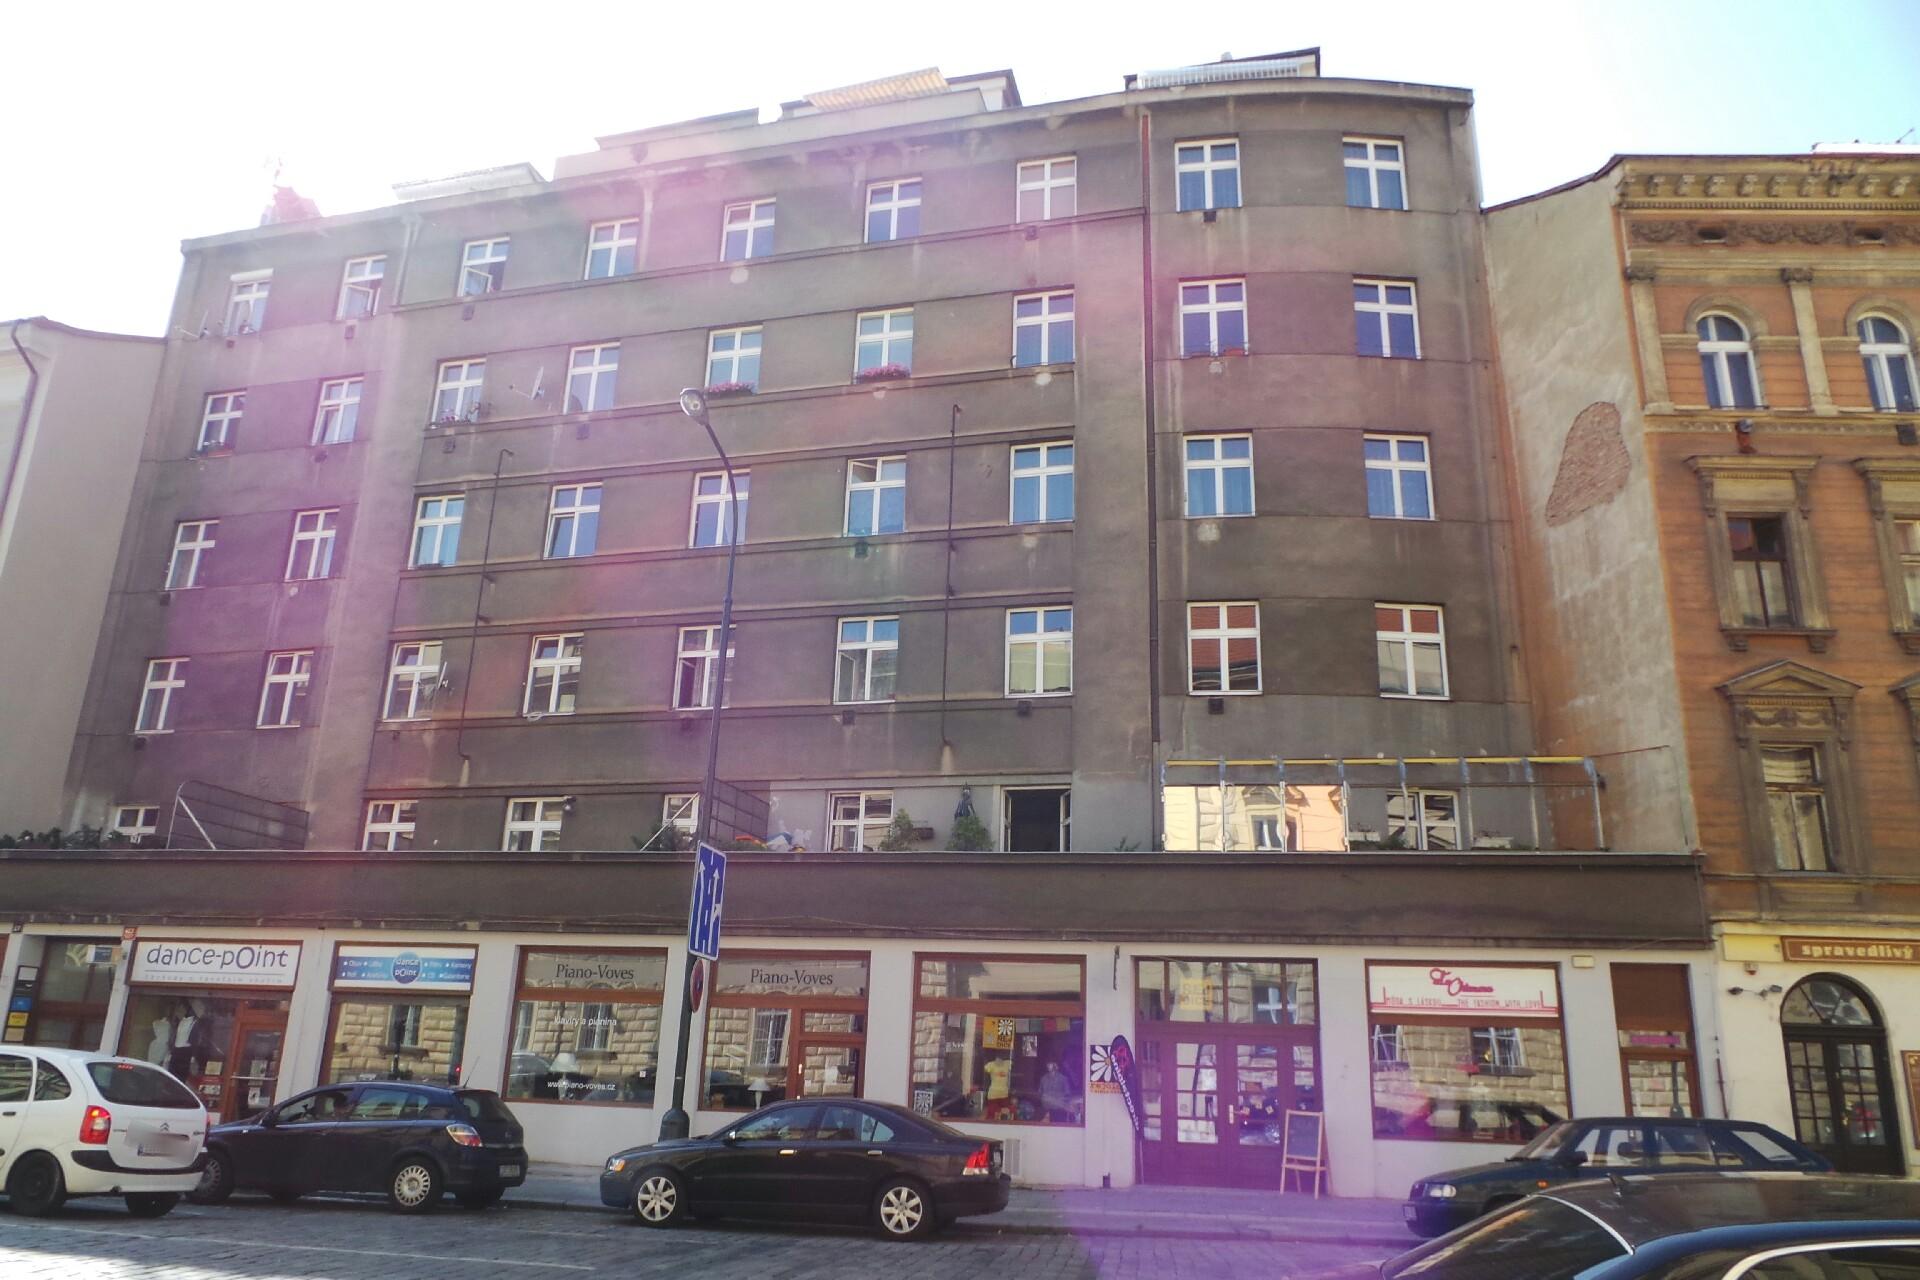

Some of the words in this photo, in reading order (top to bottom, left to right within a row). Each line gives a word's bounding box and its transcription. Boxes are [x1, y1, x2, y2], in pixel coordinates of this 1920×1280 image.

[1801, 944, 1913, 959] spravedlivý
[555, 963, 635, 980] Piano-Voves
[750, 968, 833, 984] Piano-Voves
